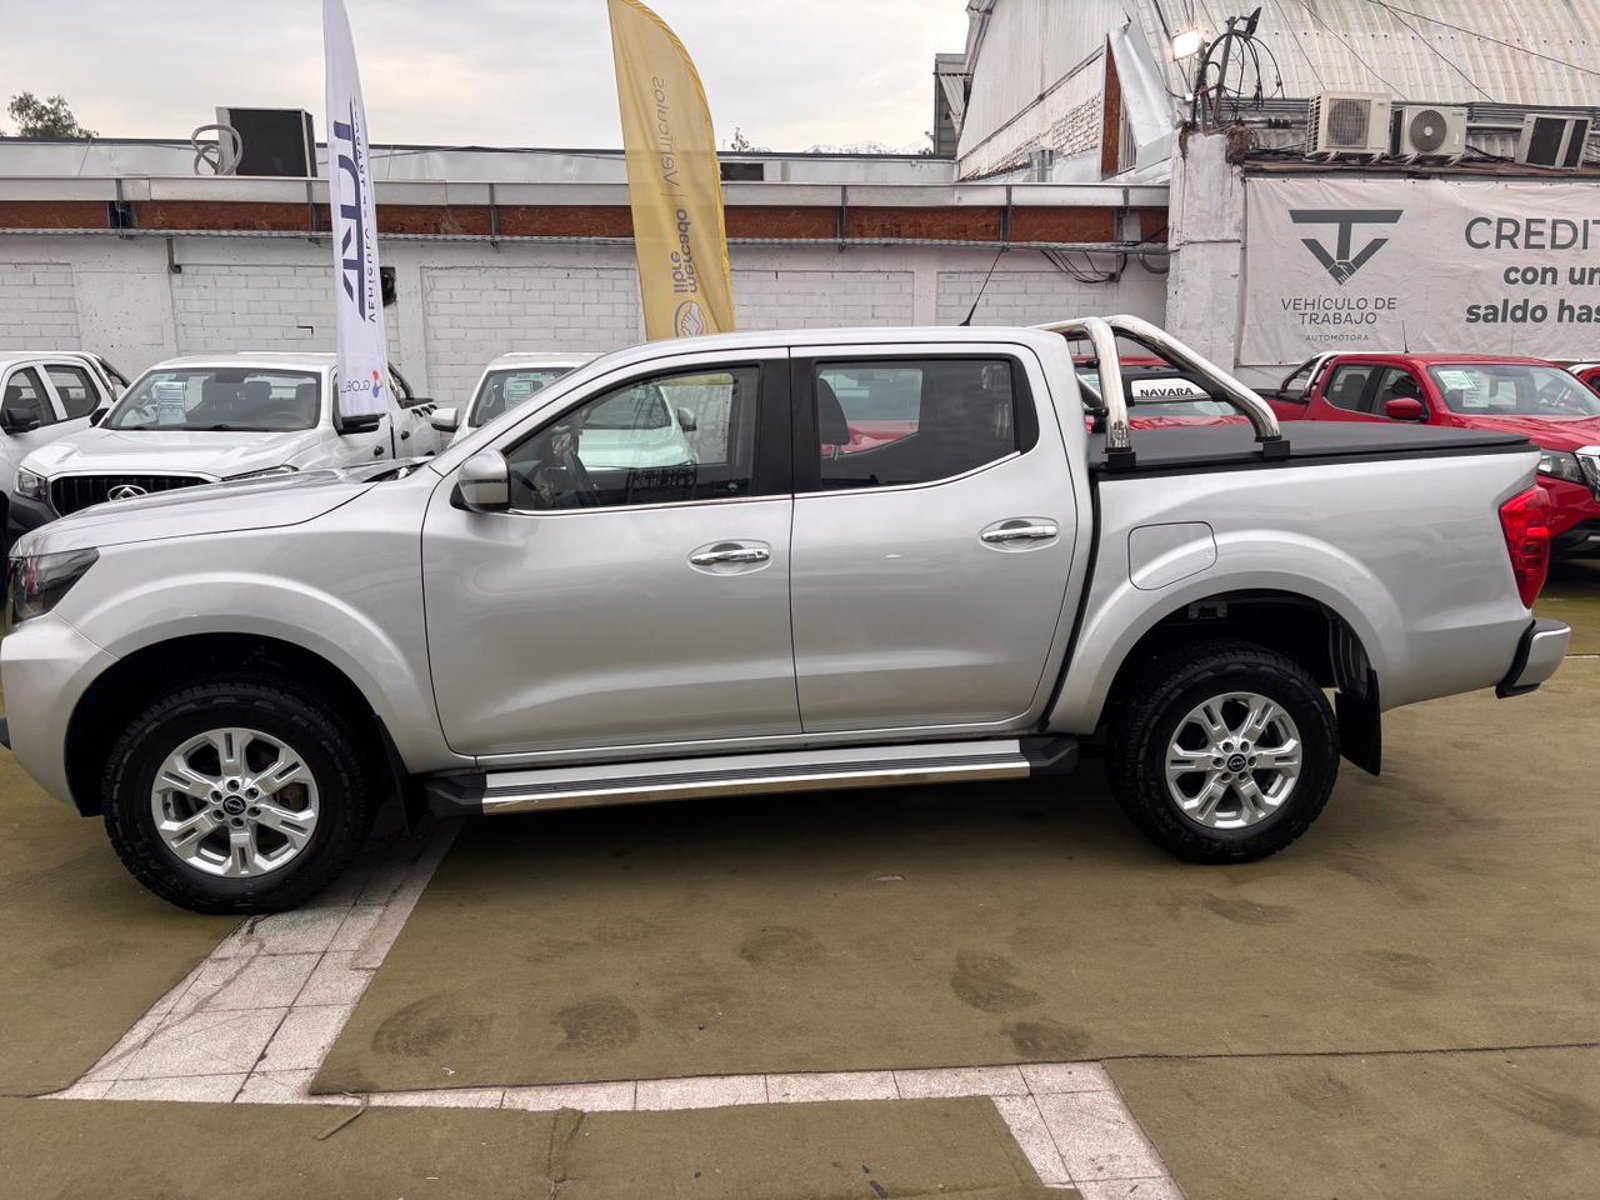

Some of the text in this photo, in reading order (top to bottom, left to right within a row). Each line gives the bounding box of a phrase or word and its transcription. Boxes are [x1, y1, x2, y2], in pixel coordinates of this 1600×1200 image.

[1503, 266, 1558, 285] con
[1281, 294, 1397, 311] VEHÍCULO DE
[1465, 298, 1548, 323] saldo
[1300, 311, 1377, 325] TRABAJO
[1140, 387, 1194, 397] NAVARA
